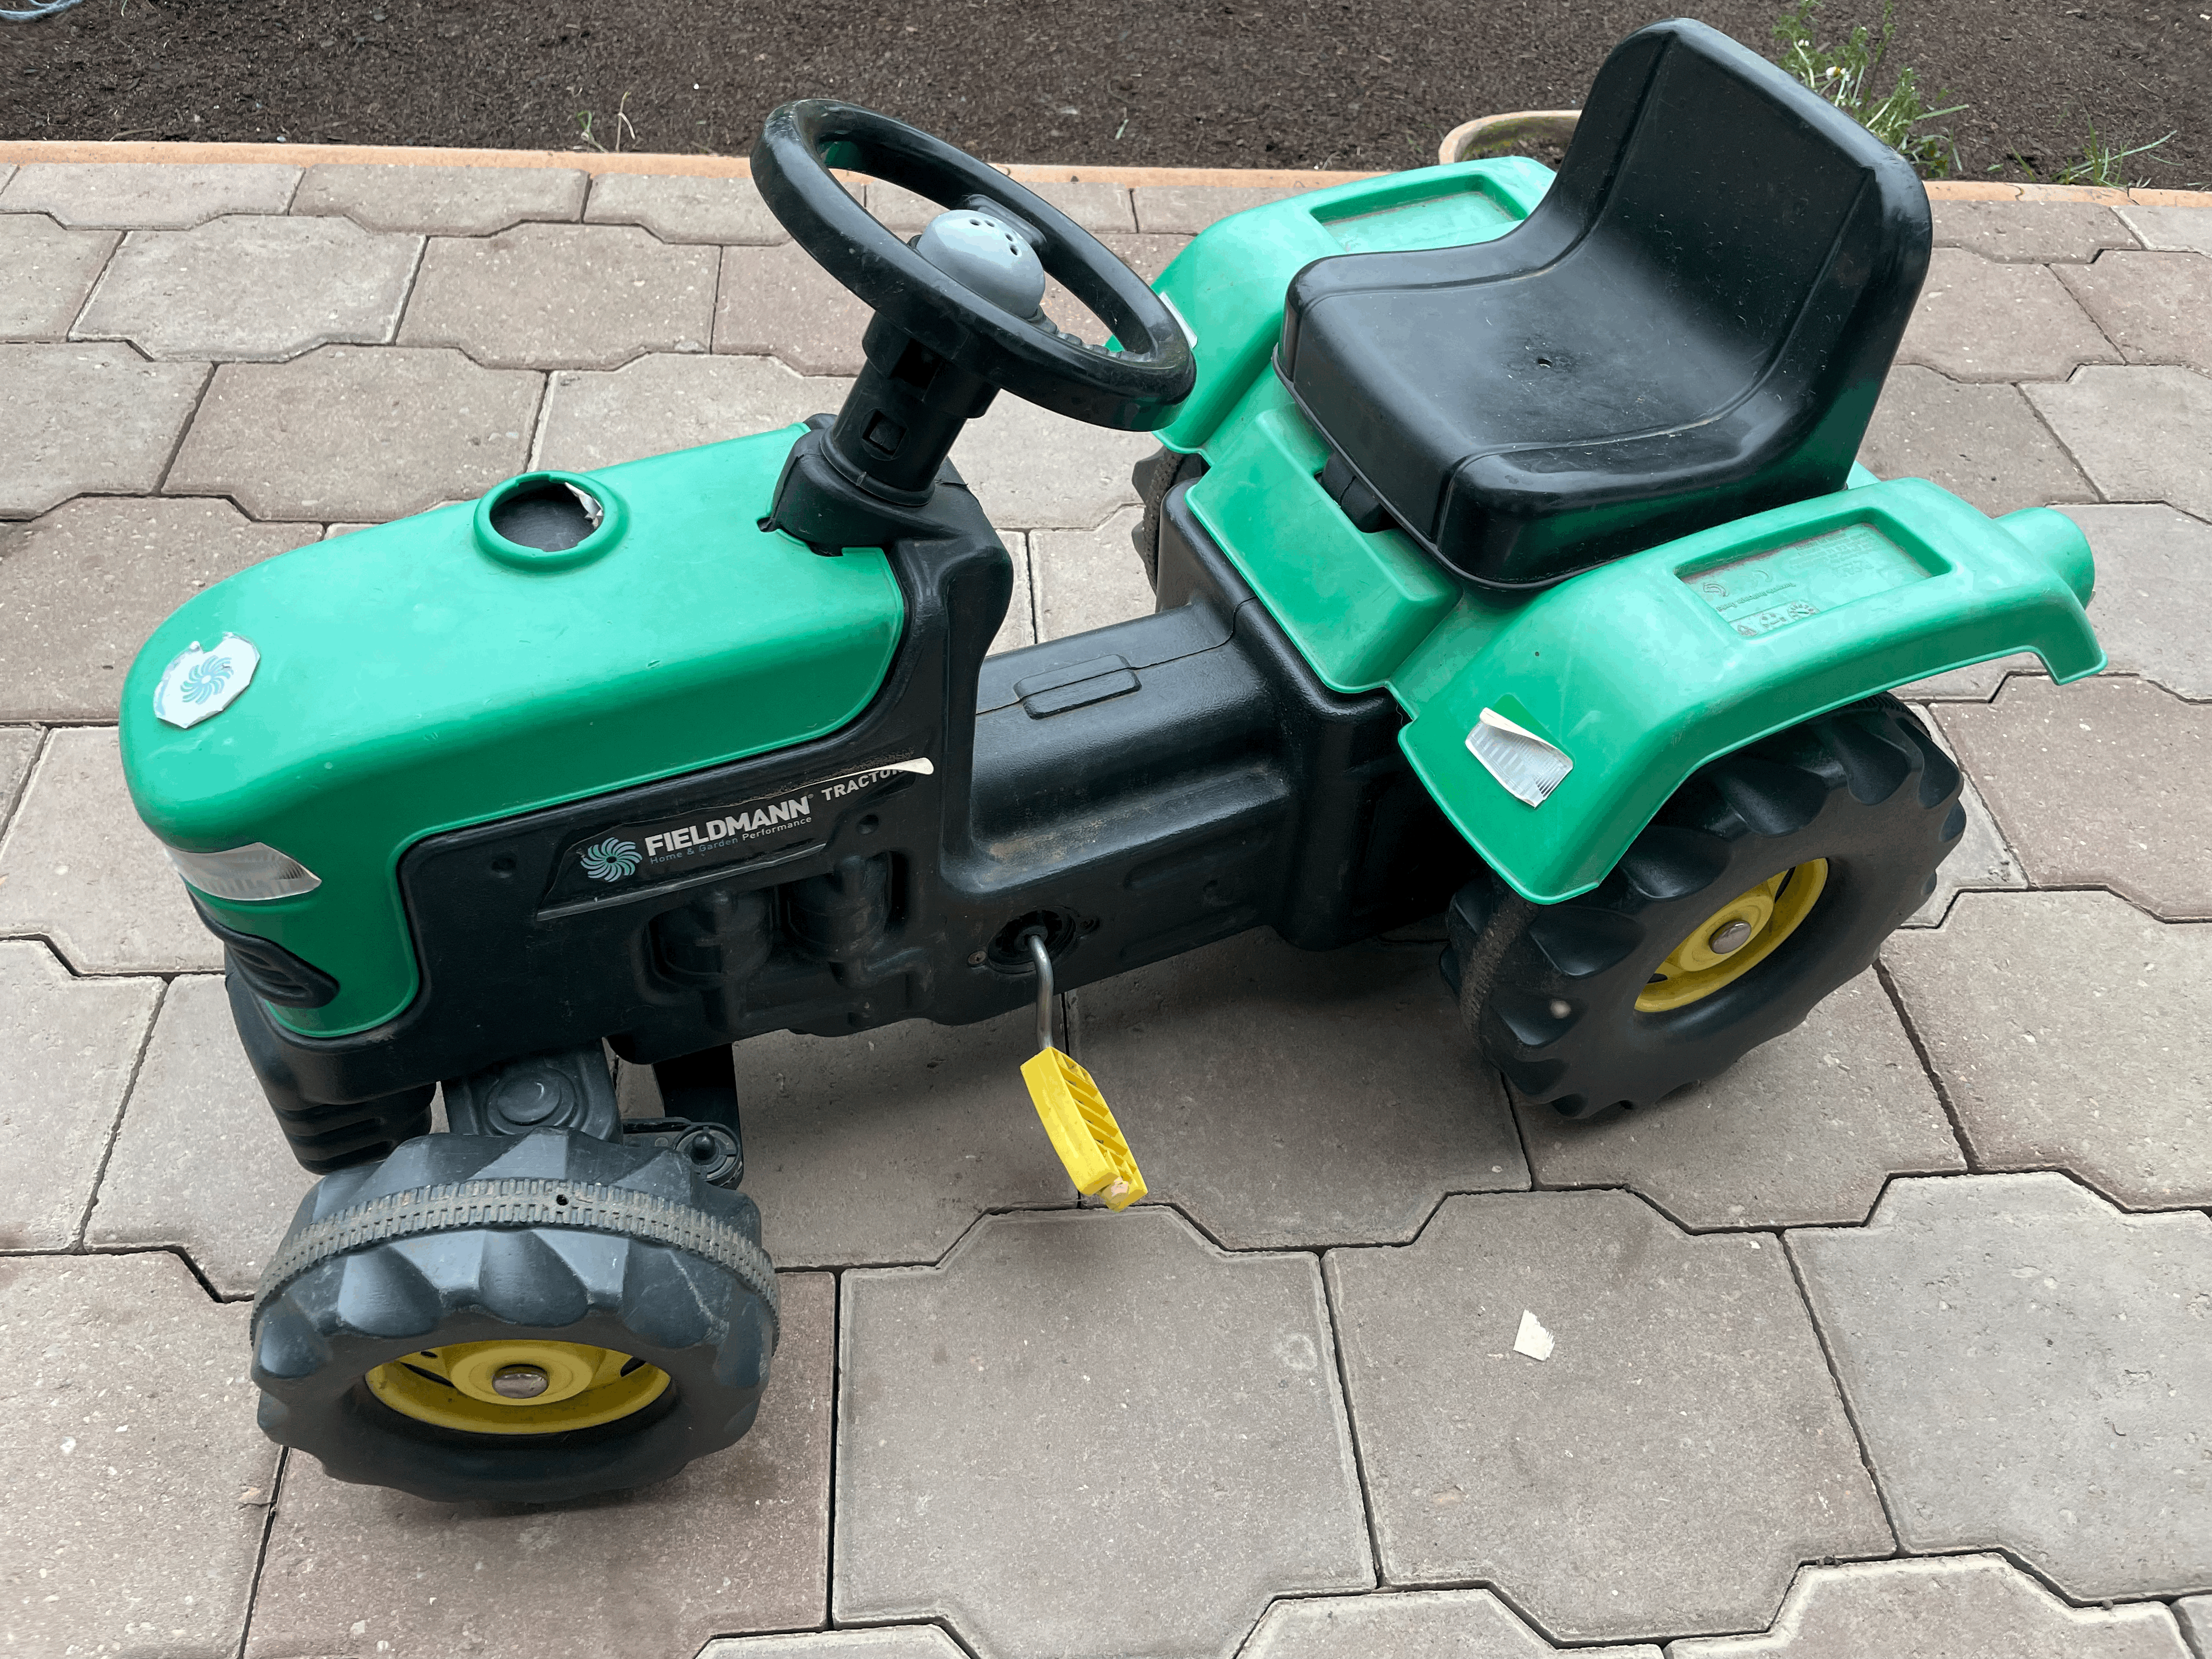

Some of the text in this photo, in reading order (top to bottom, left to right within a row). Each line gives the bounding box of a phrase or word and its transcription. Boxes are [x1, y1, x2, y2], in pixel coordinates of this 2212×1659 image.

[645, 769, 903, 856] FIELDMANN TRACTO
[650, 817, 812, 865] Home & Garden Performance
